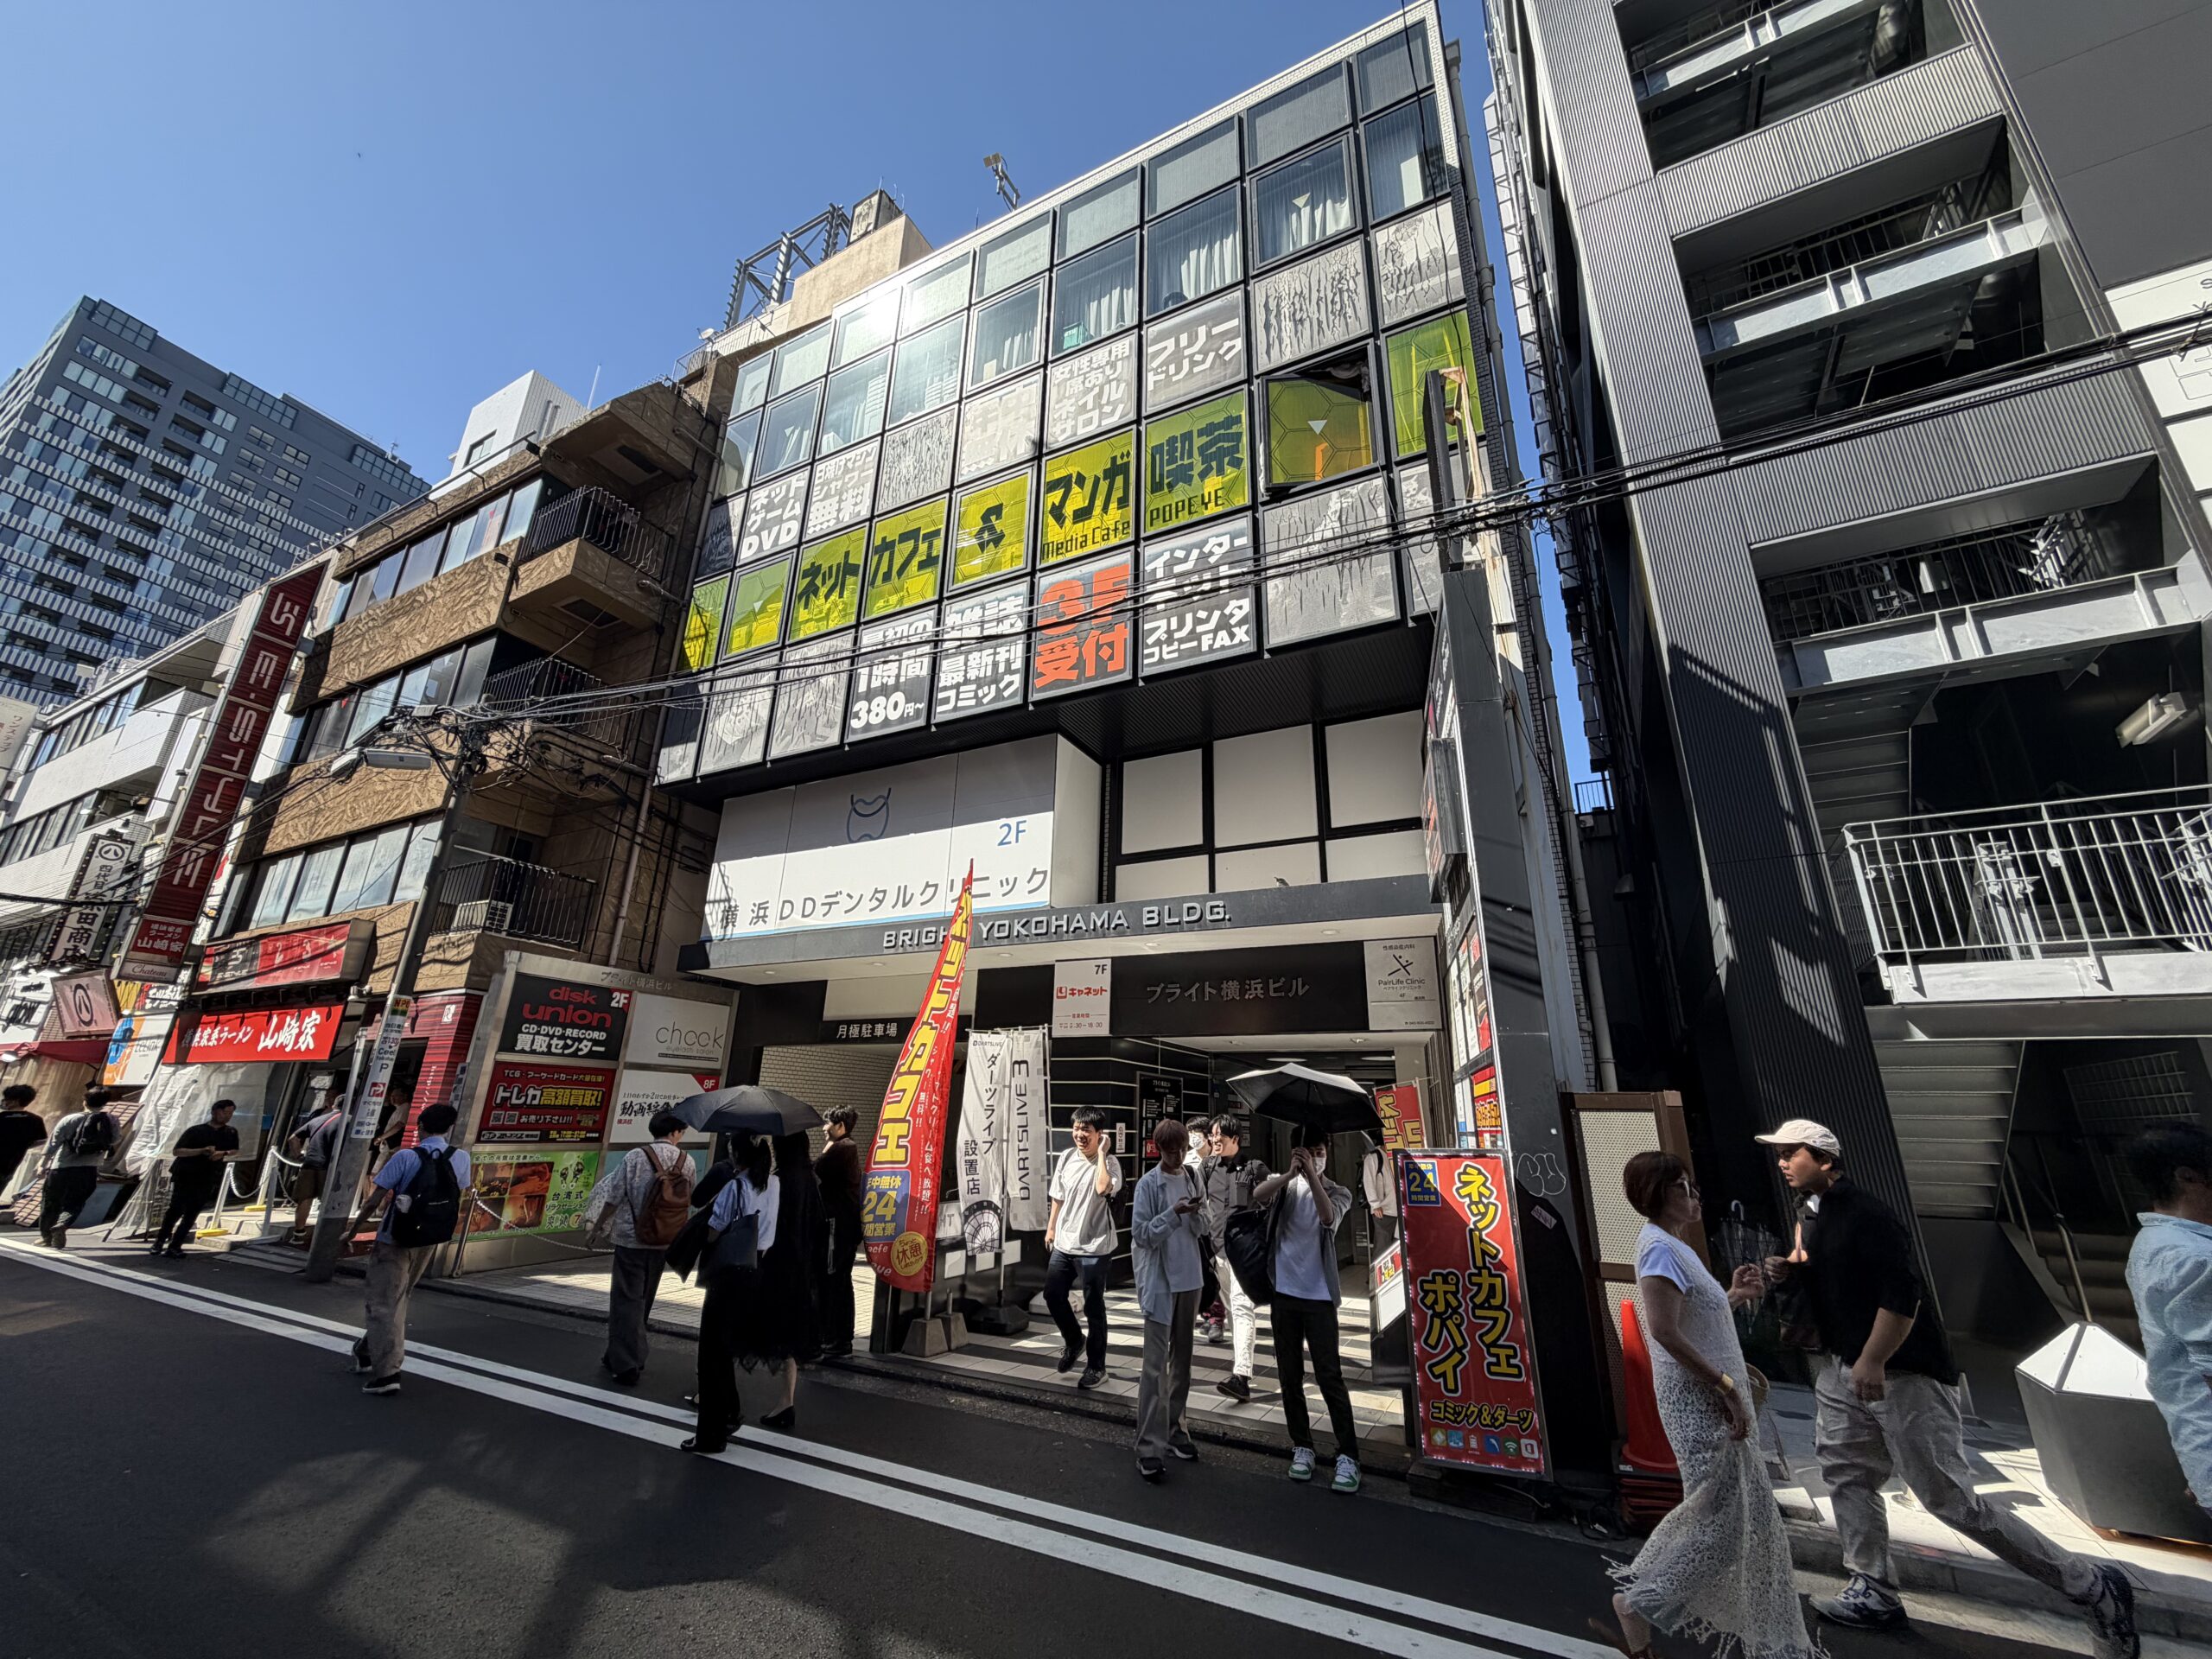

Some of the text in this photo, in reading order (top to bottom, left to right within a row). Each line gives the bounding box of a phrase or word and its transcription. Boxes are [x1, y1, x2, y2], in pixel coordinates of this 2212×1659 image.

[1147, 318, 1239, 366] フリー
[1053, 339, 1130, 383] 女性専用
[1065, 360, 1122, 396] 席あり
[1147, 337, 1242, 391] ドリンク
[1054, 383, 1126, 420] ネイル
[1054, 404, 1124, 442] サロン
[750, 474, 805, 511] ネット
[813, 468, 874, 501] シャワー
[747, 499, 801, 532] ゲーム
[797, 416, 1244, 610] ネット カフェ & マンガ 喫茶
[807, 482, 870, 534] 無料
[1149, 487, 1225, 527] POPEYE
[741, 520, 798, 559] DVD
[1041, 521, 1130, 561] Media Cafe
[1144, 534, 1248, 577] インター
[1037, 563, 1130, 635] 3F
[943, 596, 1024, 654] 雑誌
[1144, 597, 1250, 645] プリンタ
[858, 646, 930, 693] 1時間
[938, 640, 1023, 688] 最新刊
[1034, 622, 1129, 689] 受付
[937, 673, 1020, 713] コミック
[997, 820, 1027, 846] 2F
[149, 930, 181, 939] ラーメン
[883, 900, 1232, 950] BRIGH YOKOHAMA BLDG.
[132, 963, 167, 977] Chateau
[1095, 964, 1108, 975] 7F
[549, 987, 598, 1005] disk
[610, 992, 629, 1008] 2F
[1069, 986, 1108, 996] キャネット
[1147, 976, 1310, 1003] ブライト横浜ビル
[257, 1010, 321, 1052] 山崎家
[522, 1003, 613, 1028] union
[836, 1023, 898, 1039] 月極駐車場
[515, 1034, 606, 1055] 買取センター
[379, 1063, 389, 1073] P
[703, 1079, 715, 1089] 8F
[496, 1085, 603, 1107] トレカ高額買取!
[982, 1052, 1001, 1154] ダーツライブ
[1015, 1083, 1030, 1200] DARTSLIVE
[964, 1140, 981, 1196] 設置店
[1409, 1172, 1434, 1192] 24
[552, 1192, 583, 1201] 台湾式
[861, 1191, 897, 1223] 24
[864, 1223, 896, 1236] 間営業
[896, 1243, 922, 1266] 休憩
[1458, 1163, 1523, 1377] ネットカフェ
[1423, 1274, 1466, 1391] ポパイ
[1433, 1401, 1533, 1430] コミック&ダーツ
